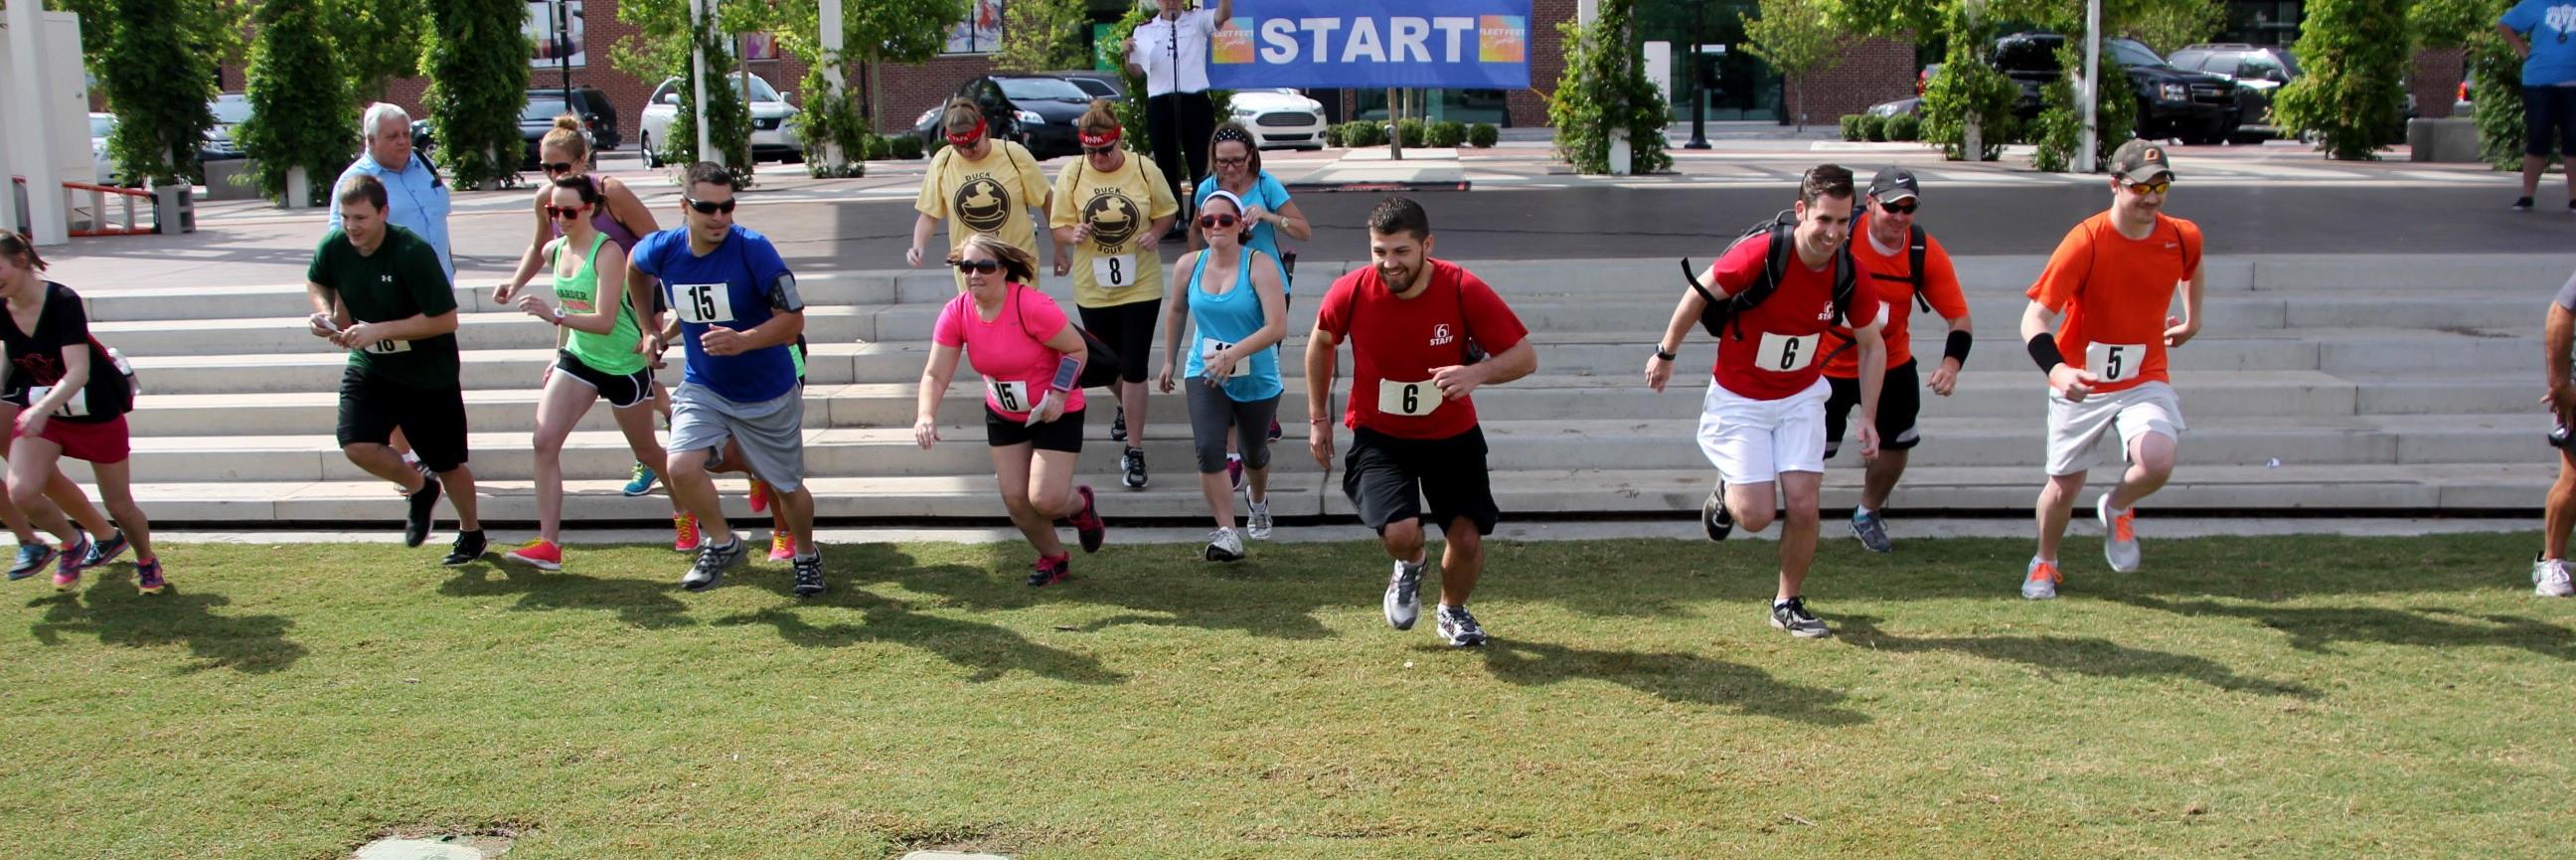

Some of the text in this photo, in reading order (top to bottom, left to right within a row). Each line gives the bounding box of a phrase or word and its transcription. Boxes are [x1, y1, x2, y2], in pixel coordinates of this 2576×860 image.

[1260, 17, 1474, 64] START
[965, 172, 991, 181] DUCK
[1109, 258, 1121, 284] 8
[689, 286, 716, 320] 15
[1430, 335, 1453, 346] STAFF
[1437, 325, 1447, 337] 6
[1781, 337, 1799, 369] 6
[2107, 346, 2124, 380] 5
[995, 382, 1018, 411] 15
[1402, 384, 1418, 414] 6
